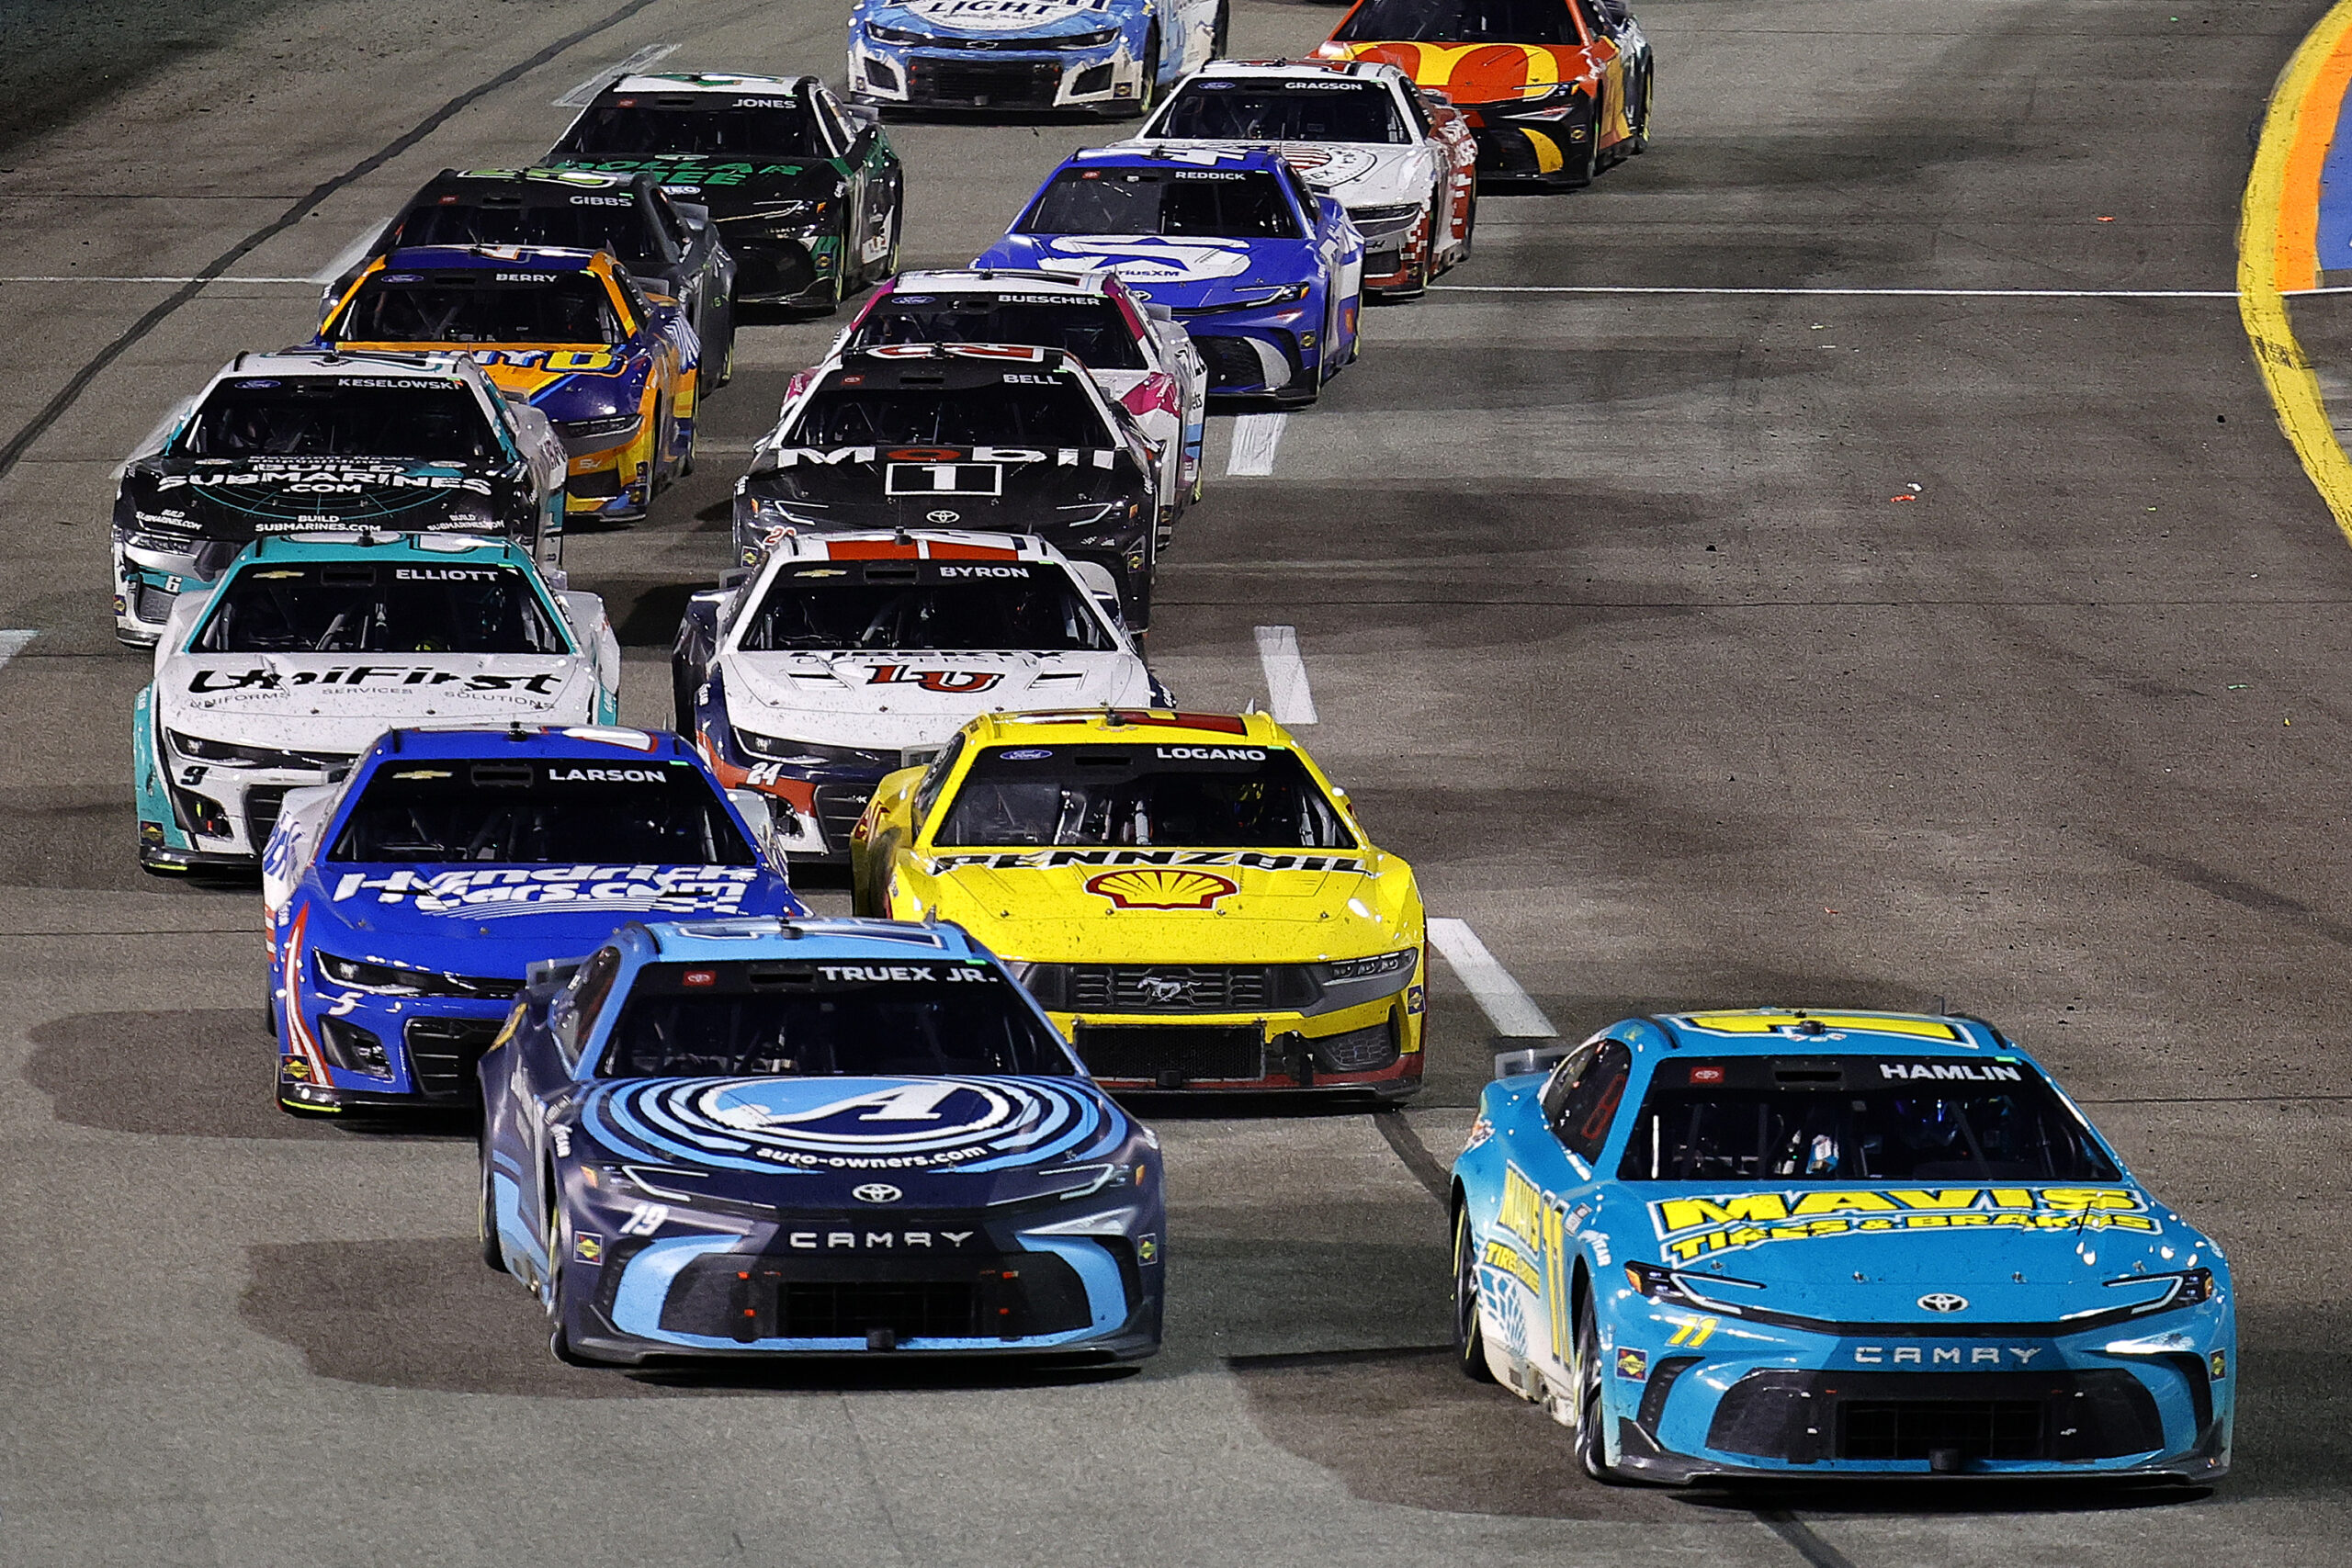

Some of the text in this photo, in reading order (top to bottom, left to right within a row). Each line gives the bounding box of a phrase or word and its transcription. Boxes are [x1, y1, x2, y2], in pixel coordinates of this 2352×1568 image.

[927, 0, 1054, 16] LIGHT
[1285, 82, 1362, 90] GRAGSON
[732, 99, 797, 108] JONES
[1175, 172, 1246, 181] REDDICK
[569, 196, 632, 207] GIBBS
[496, 273, 558, 282] BERRY
[999, 295, 1101, 306] BUESCHER
[338, 378, 461, 389] KESELOWSKI
[1003, 375, 1062, 385] BELL
[157, 471, 492, 497] SUBMARINES
[922, 466, 956, 491] 1
[282, 484, 362, 493] .COM
[395, 569, 499, 582] ELLIOTT
[940, 567, 1030, 579] BYRON
[165, 575, 182, 592] 6
[190, 692, 292, 708] UNIFORMS
[445, 690, 555, 710] SOLUTIONS
[1156, 747, 1267, 761] LOGANO
[180, 766, 209, 785] 9
[549, 769, 666, 784] LARSON
[746, 761, 784, 786] 24
[818, 967, 999, 983] TRUEX JR.
[1879, 1064, 2022, 1081] HAMLIN
[755, 1146, 989, 1168] auto-owners.com
[1657, 1188, 2141, 1234] MAVIS
[619, 1205, 668, 1235] 19
[789, 1232, 974, 1248] CAMRY
[1669, 1218, 1850, 1261] TIRES
[1667, 1316, 1720, 1348] 11
[1854, 1347, 2043, 1364] CAMRY
